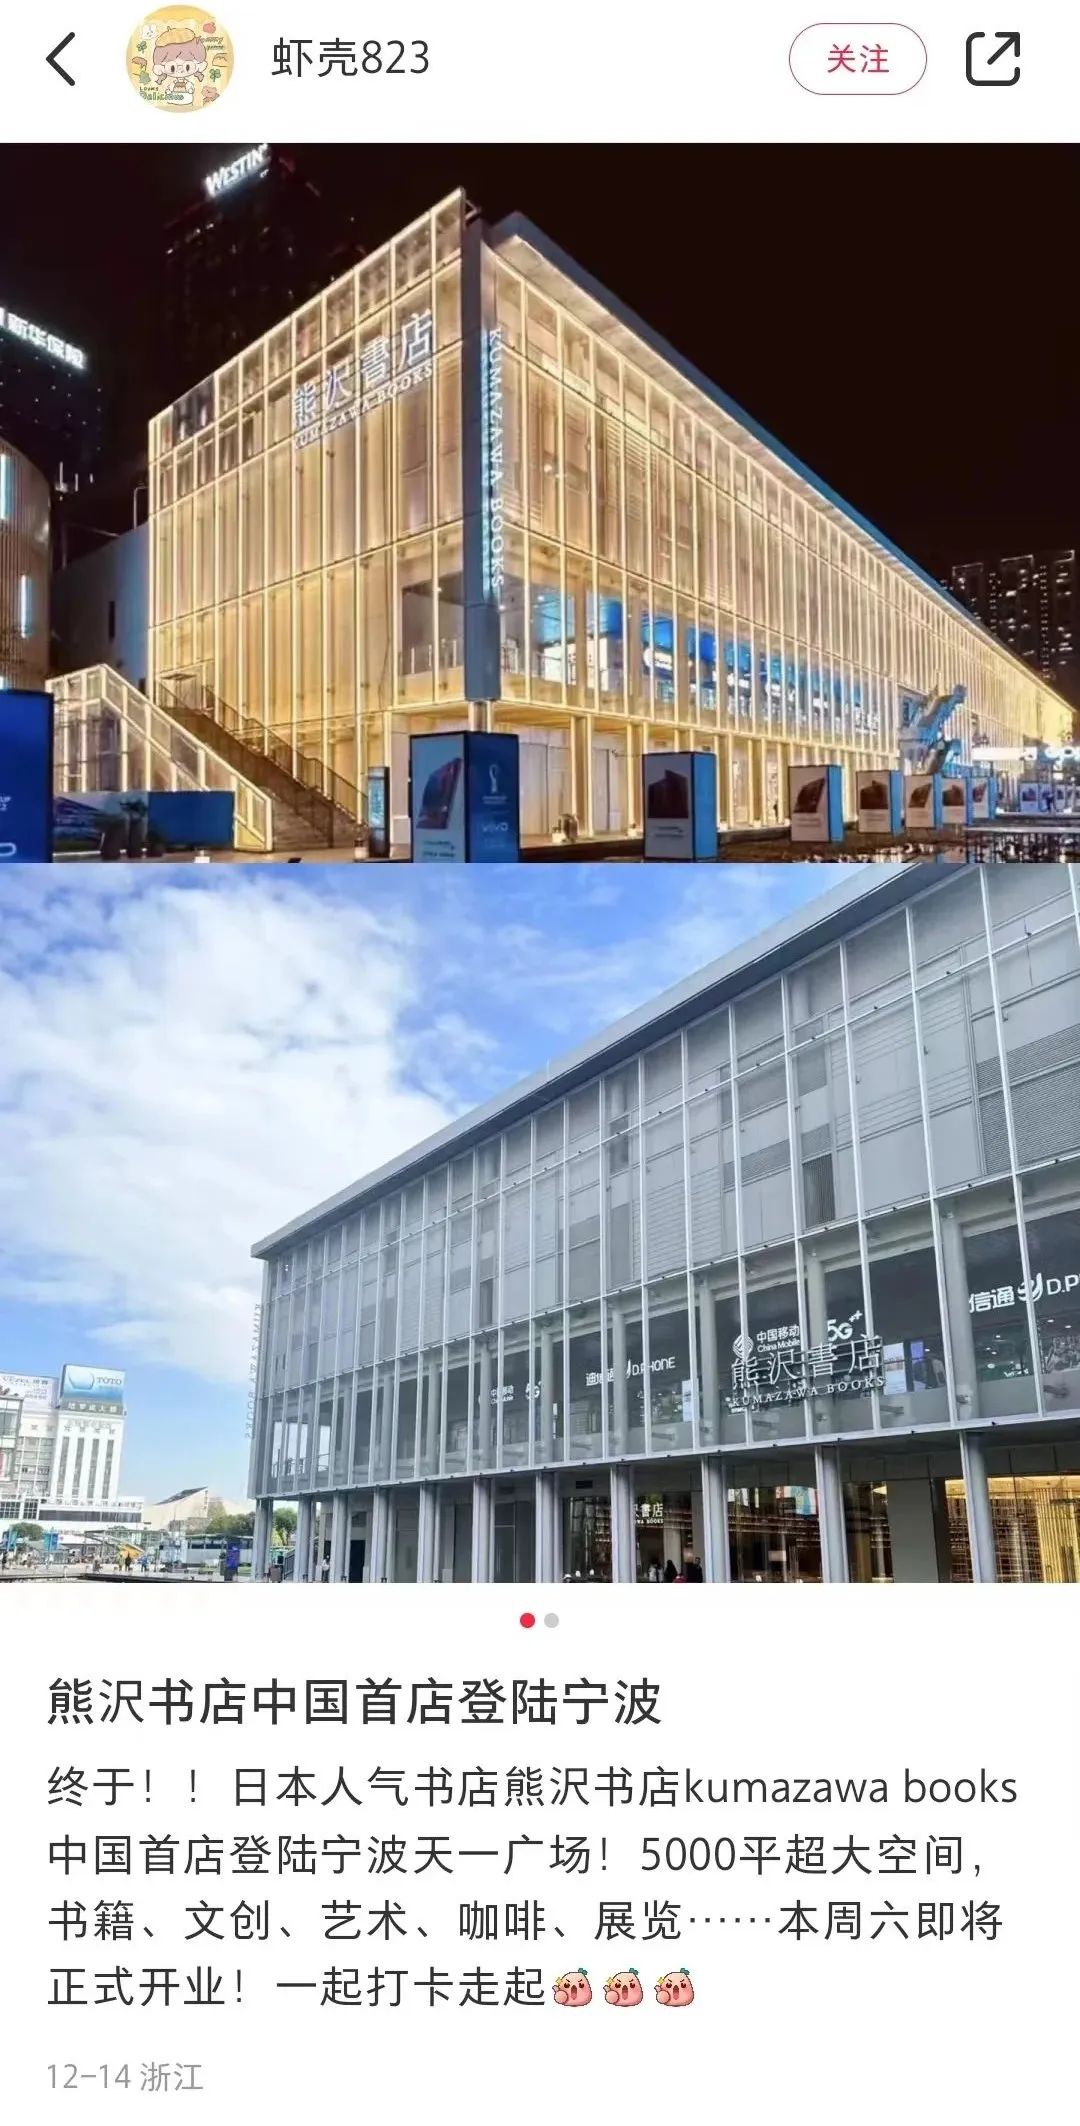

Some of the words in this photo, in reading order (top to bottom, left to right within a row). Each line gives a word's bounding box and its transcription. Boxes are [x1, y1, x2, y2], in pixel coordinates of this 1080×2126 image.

[377, 362, 433, 404] BOOKS
[489, 328, 504, 487] KUMAZAWA
[490, 498, 505, 587] BOOKS
[1046, 1274, 1080, 1295] D.P
[756, 1324, 800, 1344] 中国移动
[756, 1342, 778, 1353] China
[779, 1338, 800, 1349] Mobile
[731, 1333, 883, 1391] 熊沢書店
[732, 1386, 819, 1407] KUMAZAWA
[826, 1376, 885, 1394] BOOKS
